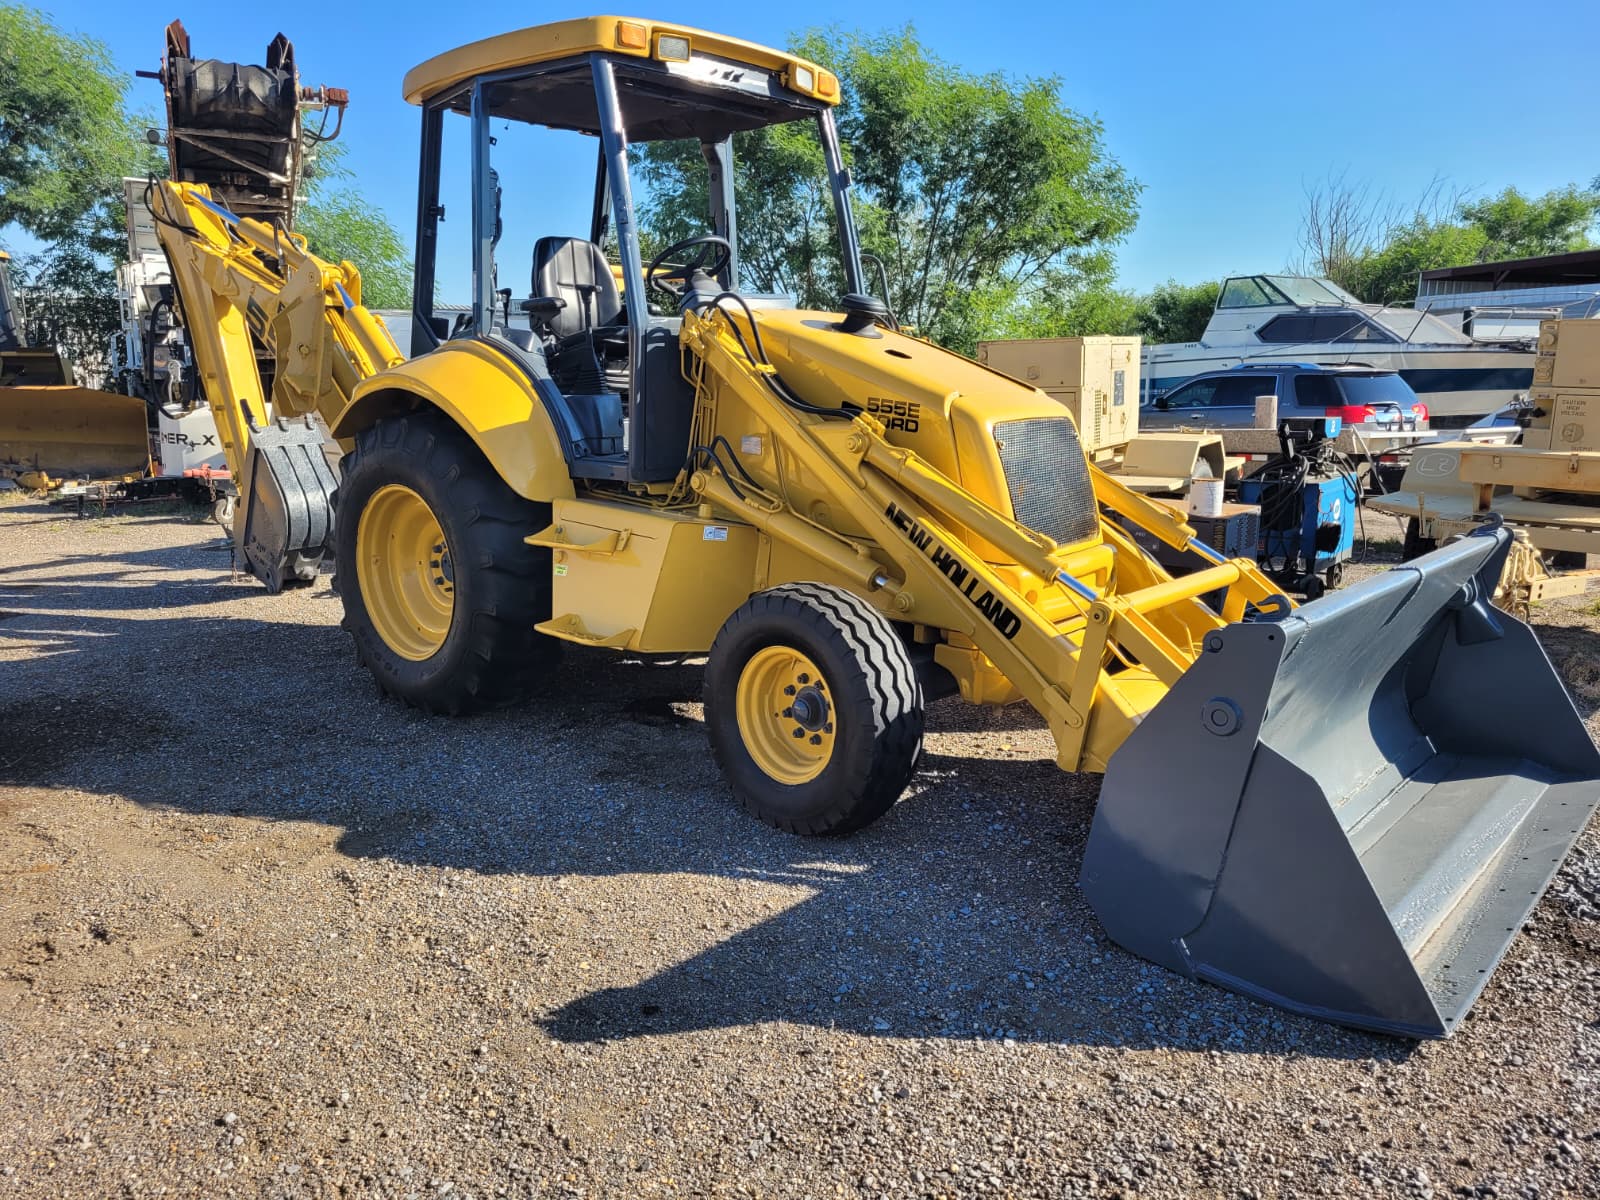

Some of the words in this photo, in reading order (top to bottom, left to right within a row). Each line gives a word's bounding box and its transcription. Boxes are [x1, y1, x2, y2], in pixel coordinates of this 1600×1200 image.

[867, 396, 920, 419] 555E
[885, 501, 933, 552] NEW
[931, 545, 1022, 640] HOLLAND
